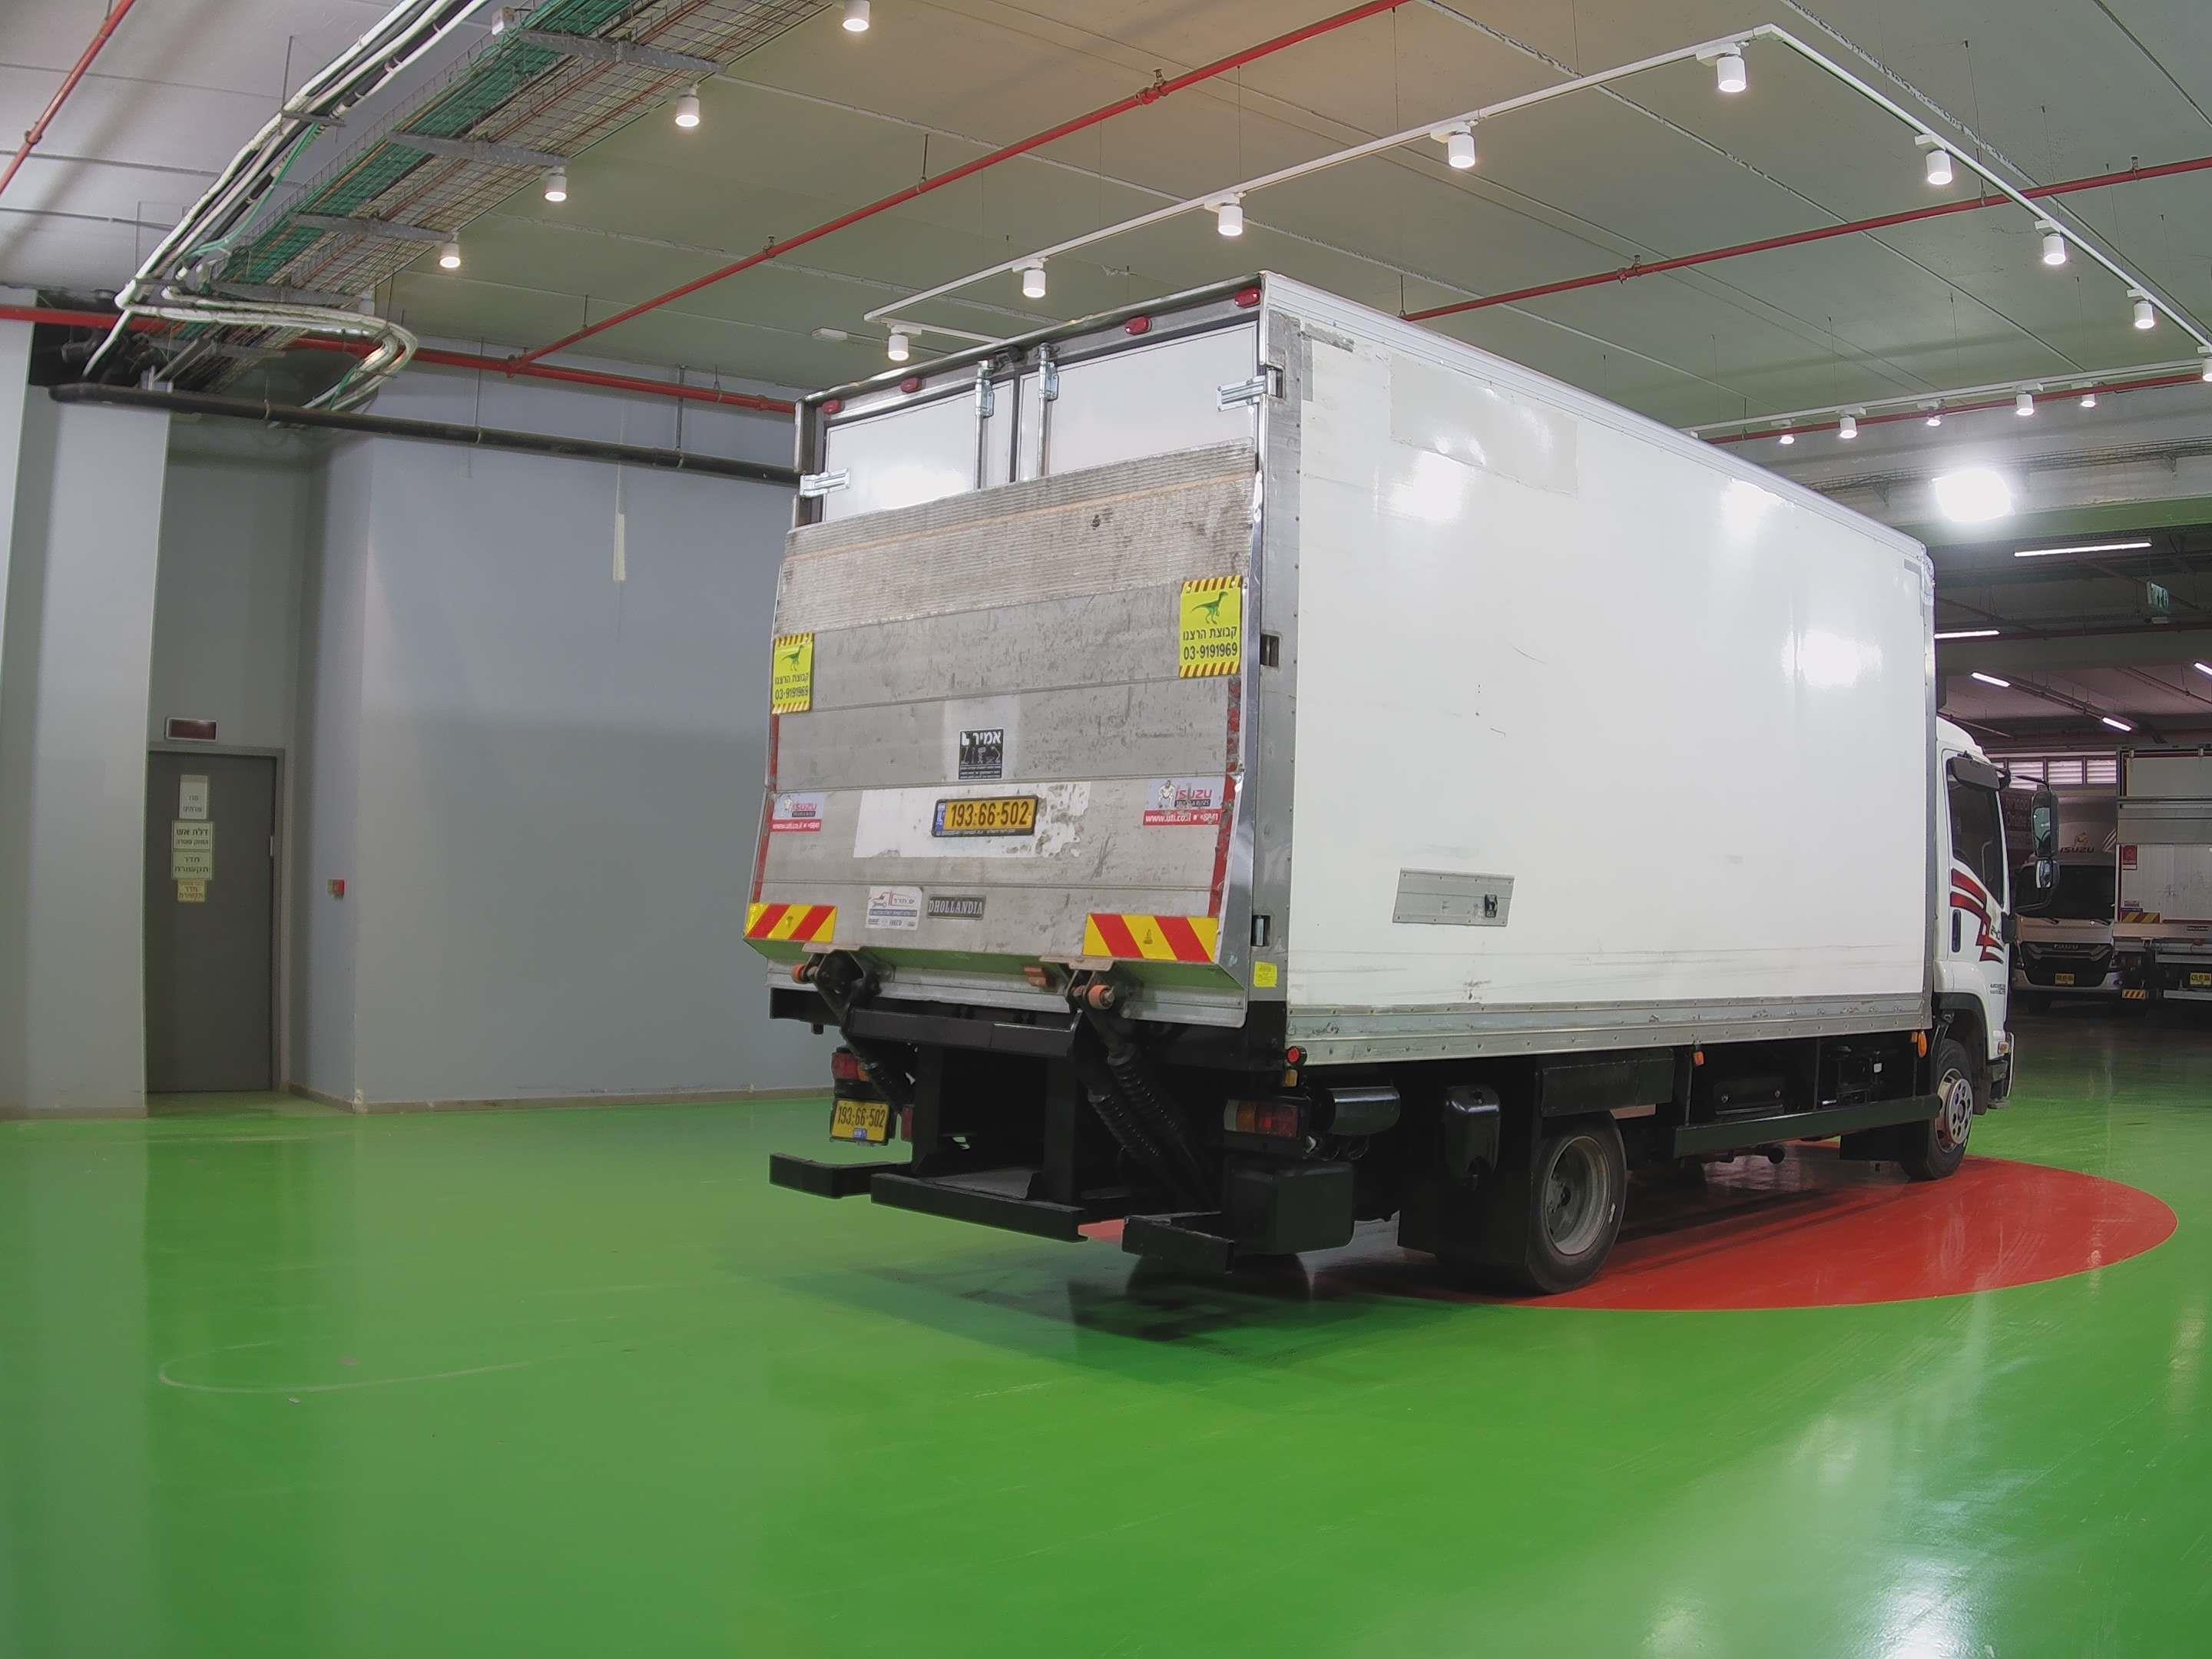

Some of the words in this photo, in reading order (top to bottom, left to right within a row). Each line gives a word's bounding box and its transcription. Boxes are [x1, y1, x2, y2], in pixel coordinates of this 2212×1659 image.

[1183, 629, 1207, 641] הרצנו
[1210, 626, 1237, 639] קבוצת
[1184, 642, 1238, 660] 03-9191969
[972, 731, 1002, 745] אמיר
[1175, 787, 1213, 800] ISUZU
[192, 828, 208, 836] דלת
[928, 899, 983, 914] DHOLLANDIA
